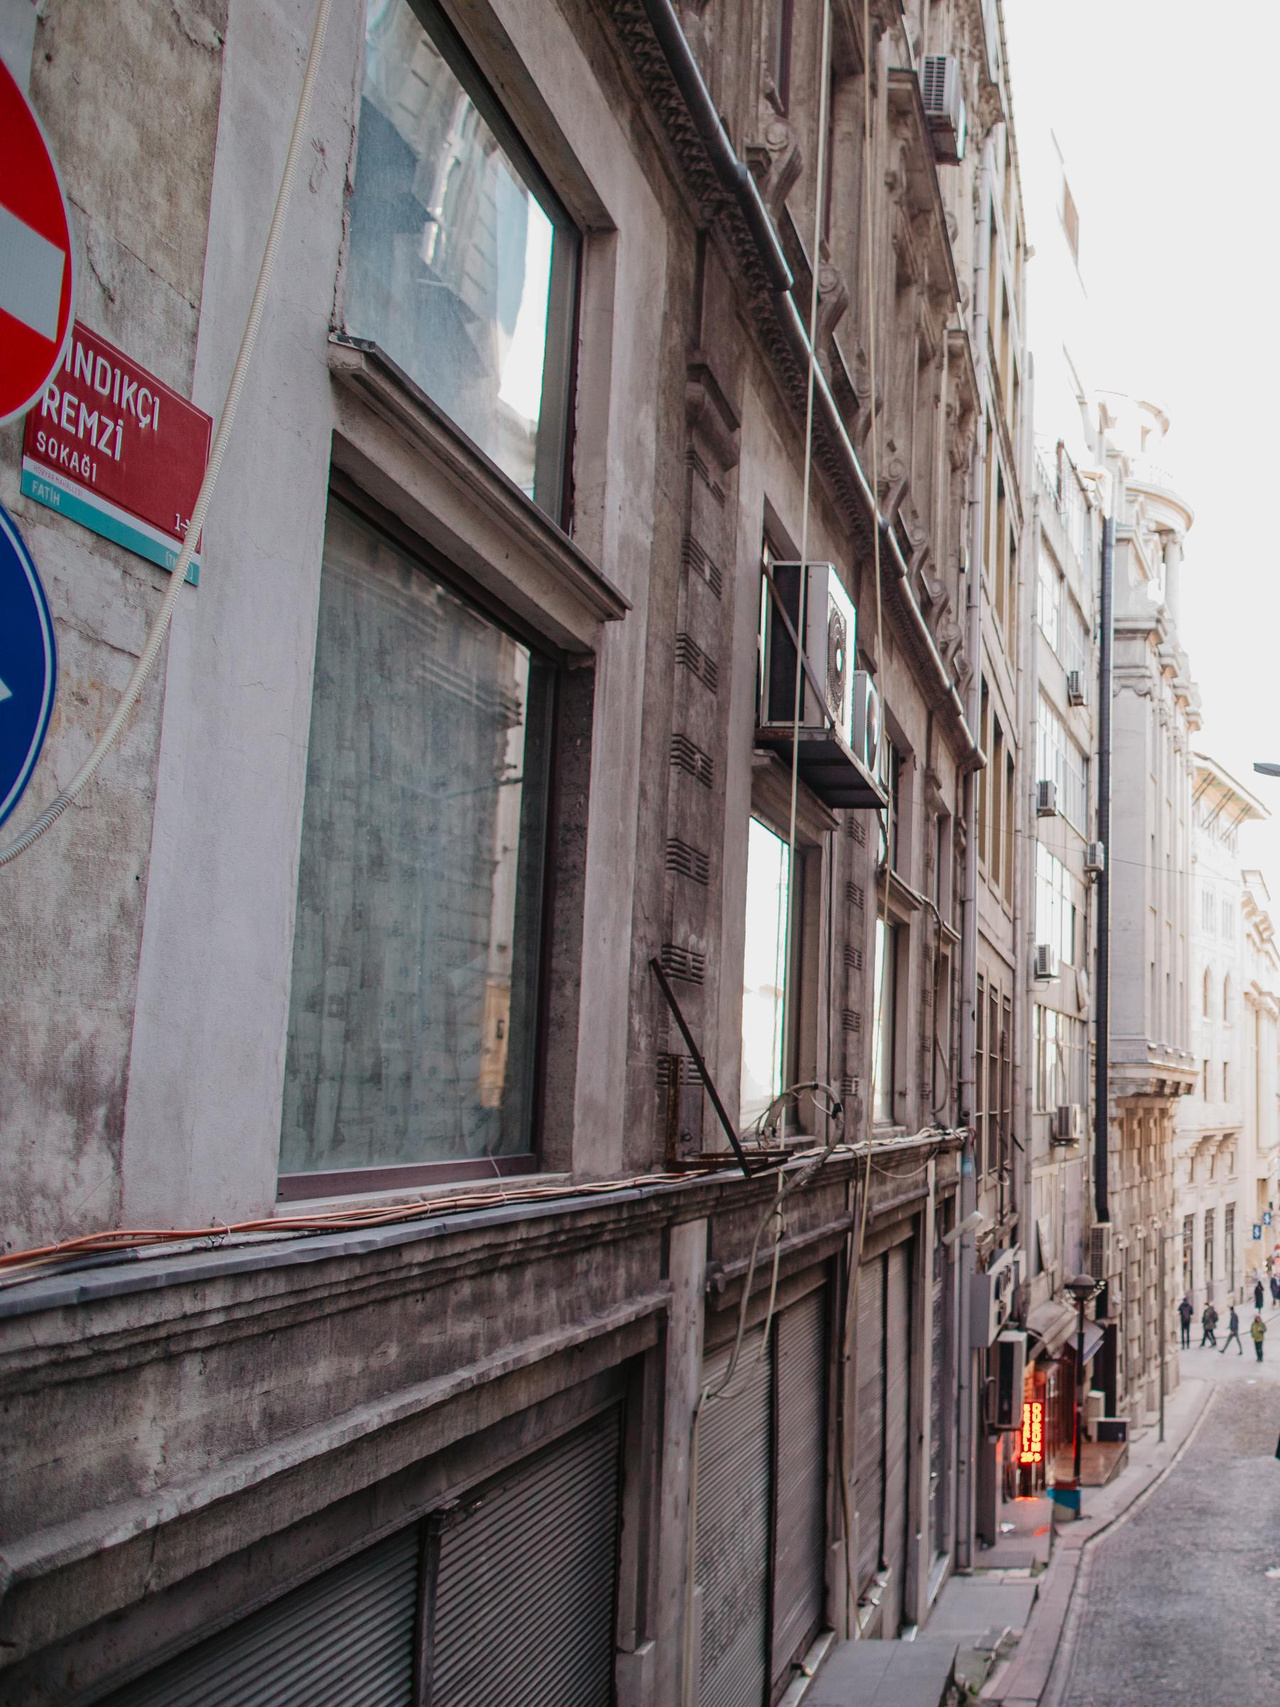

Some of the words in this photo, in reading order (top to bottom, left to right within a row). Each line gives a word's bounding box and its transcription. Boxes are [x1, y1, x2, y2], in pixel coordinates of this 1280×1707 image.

[64, 336, 160, 431] INDIKÇI
[41, 383, 124, 462] REMZİ
[36, 431, 97, 482] SOKAĞI
[31, 479, 61, 507] FATİH
